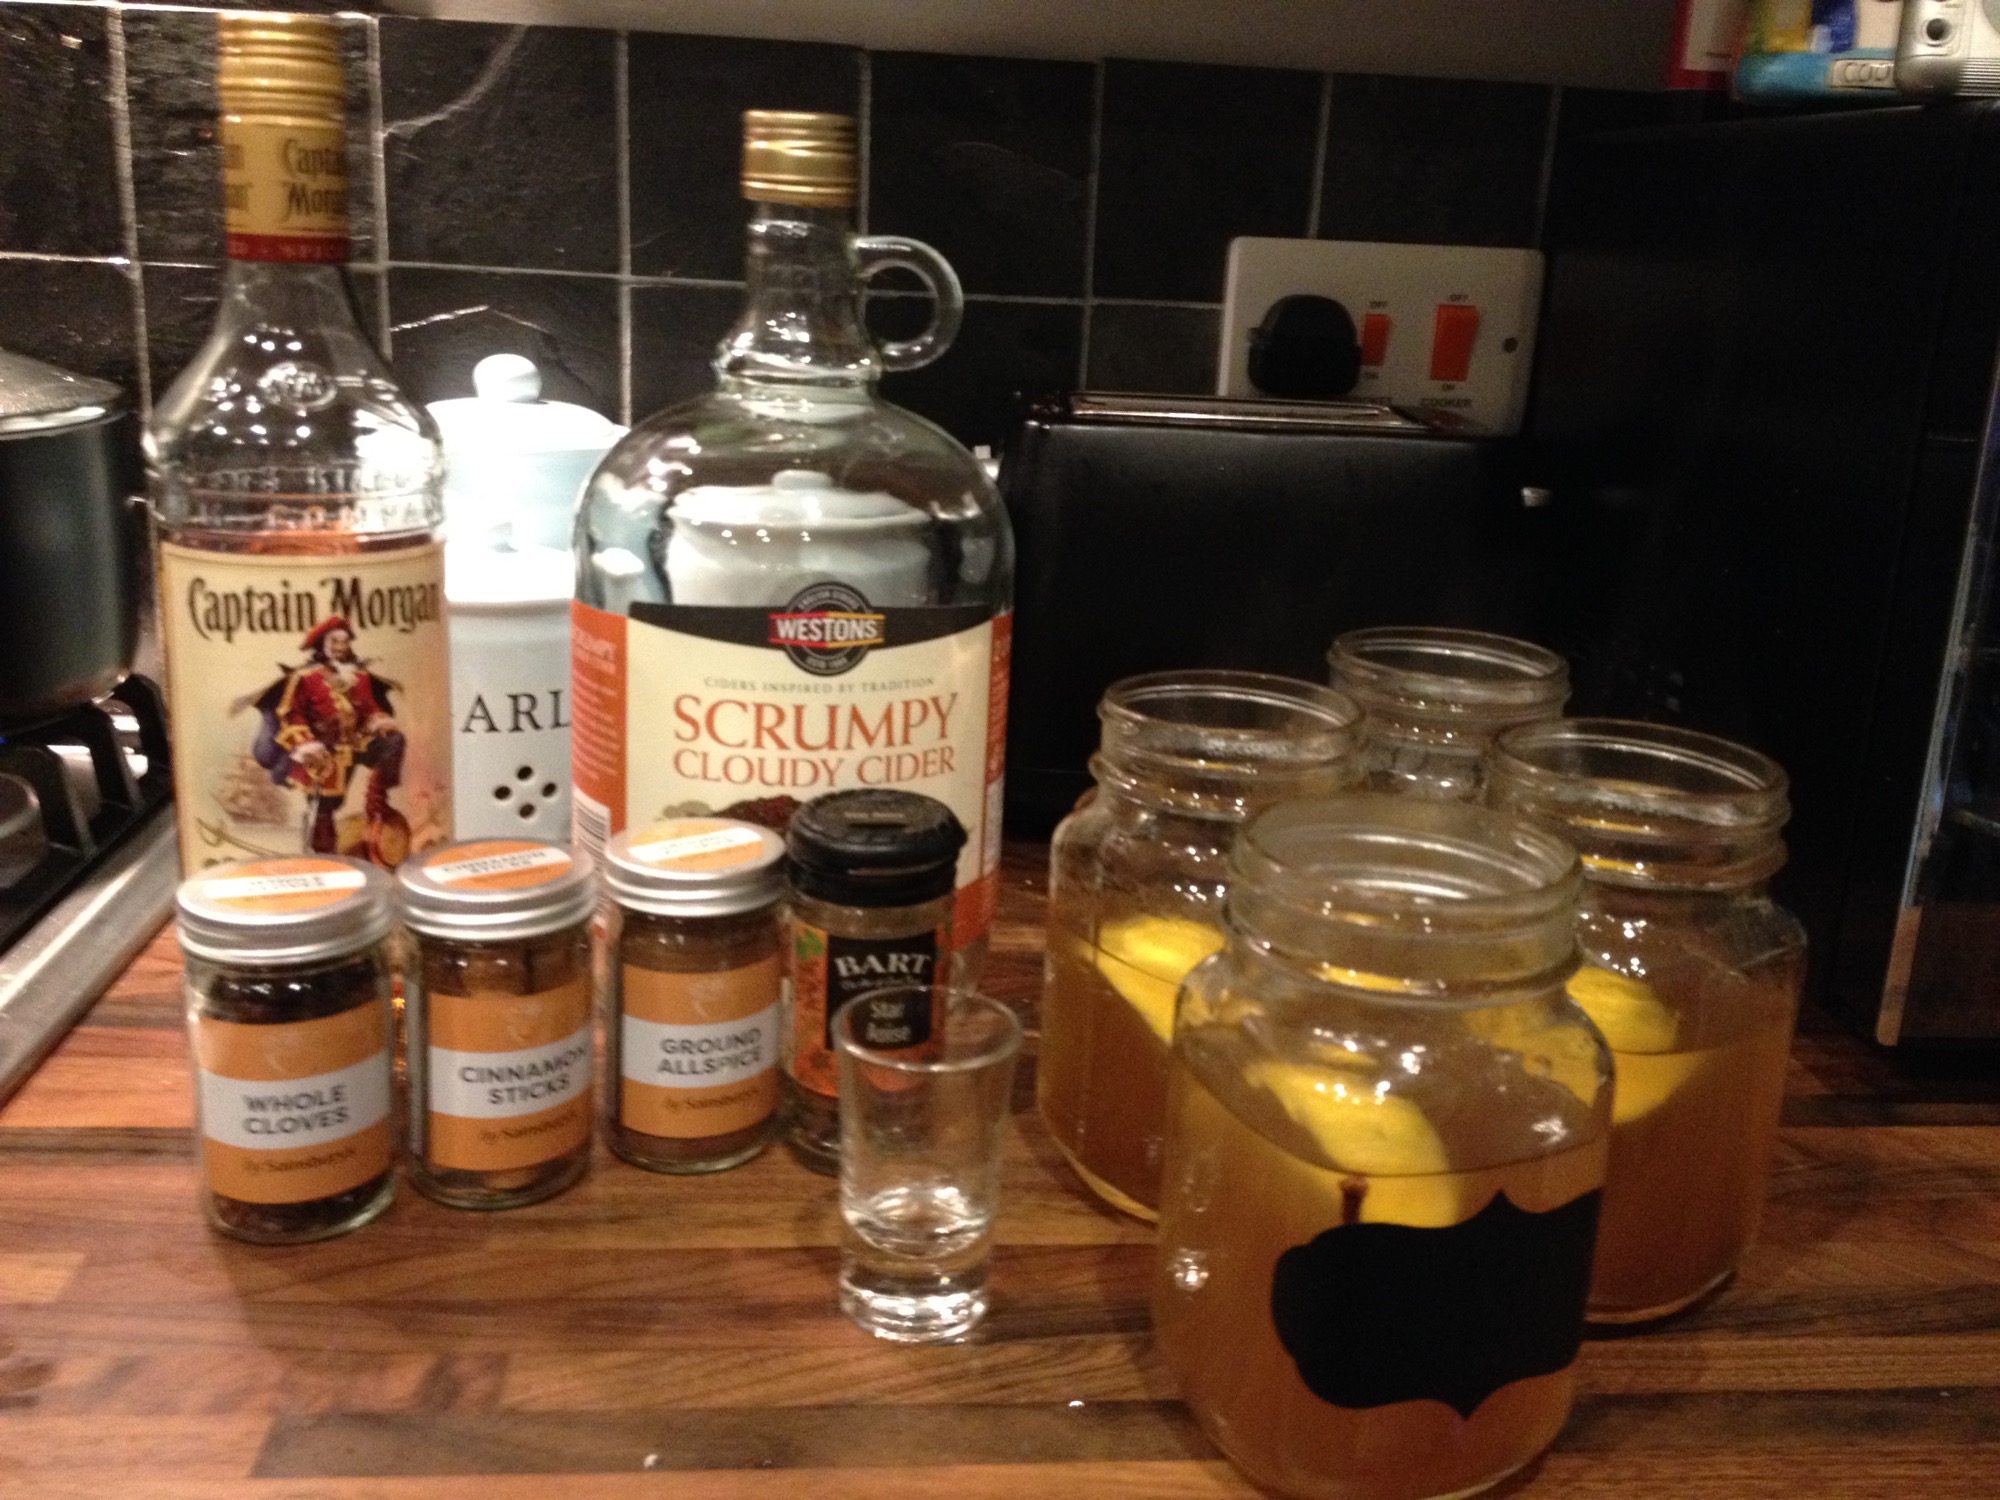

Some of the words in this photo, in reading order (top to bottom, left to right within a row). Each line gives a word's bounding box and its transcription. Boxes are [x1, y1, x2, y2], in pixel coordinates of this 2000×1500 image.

[187, 576, 317, 643] Captain
[776, 617, 878, 642] WESTONS
[704, 676, 757, 691] CIDERS
[763, 681, 832, 694] INSPIRED
[839, 681, 854, 692] BY
[861, 677, 934, 692] TRADITION
[674, 692, 958, 751] SCRUMPY
[674, 747, 843, 787] CLOUDY
[857, 746, 955, 785] CIDER
[834, 953, 932, 977] BART
[661, 1027, 762, 1055] GROUND
[658, 1046, 762, 1075] ALLSPICE
[243, 1084, 346, 1112] WHOLE
[488, 1073, 570, 1105] STICKS
[243, 1106, 350, 1134] CLOVES
